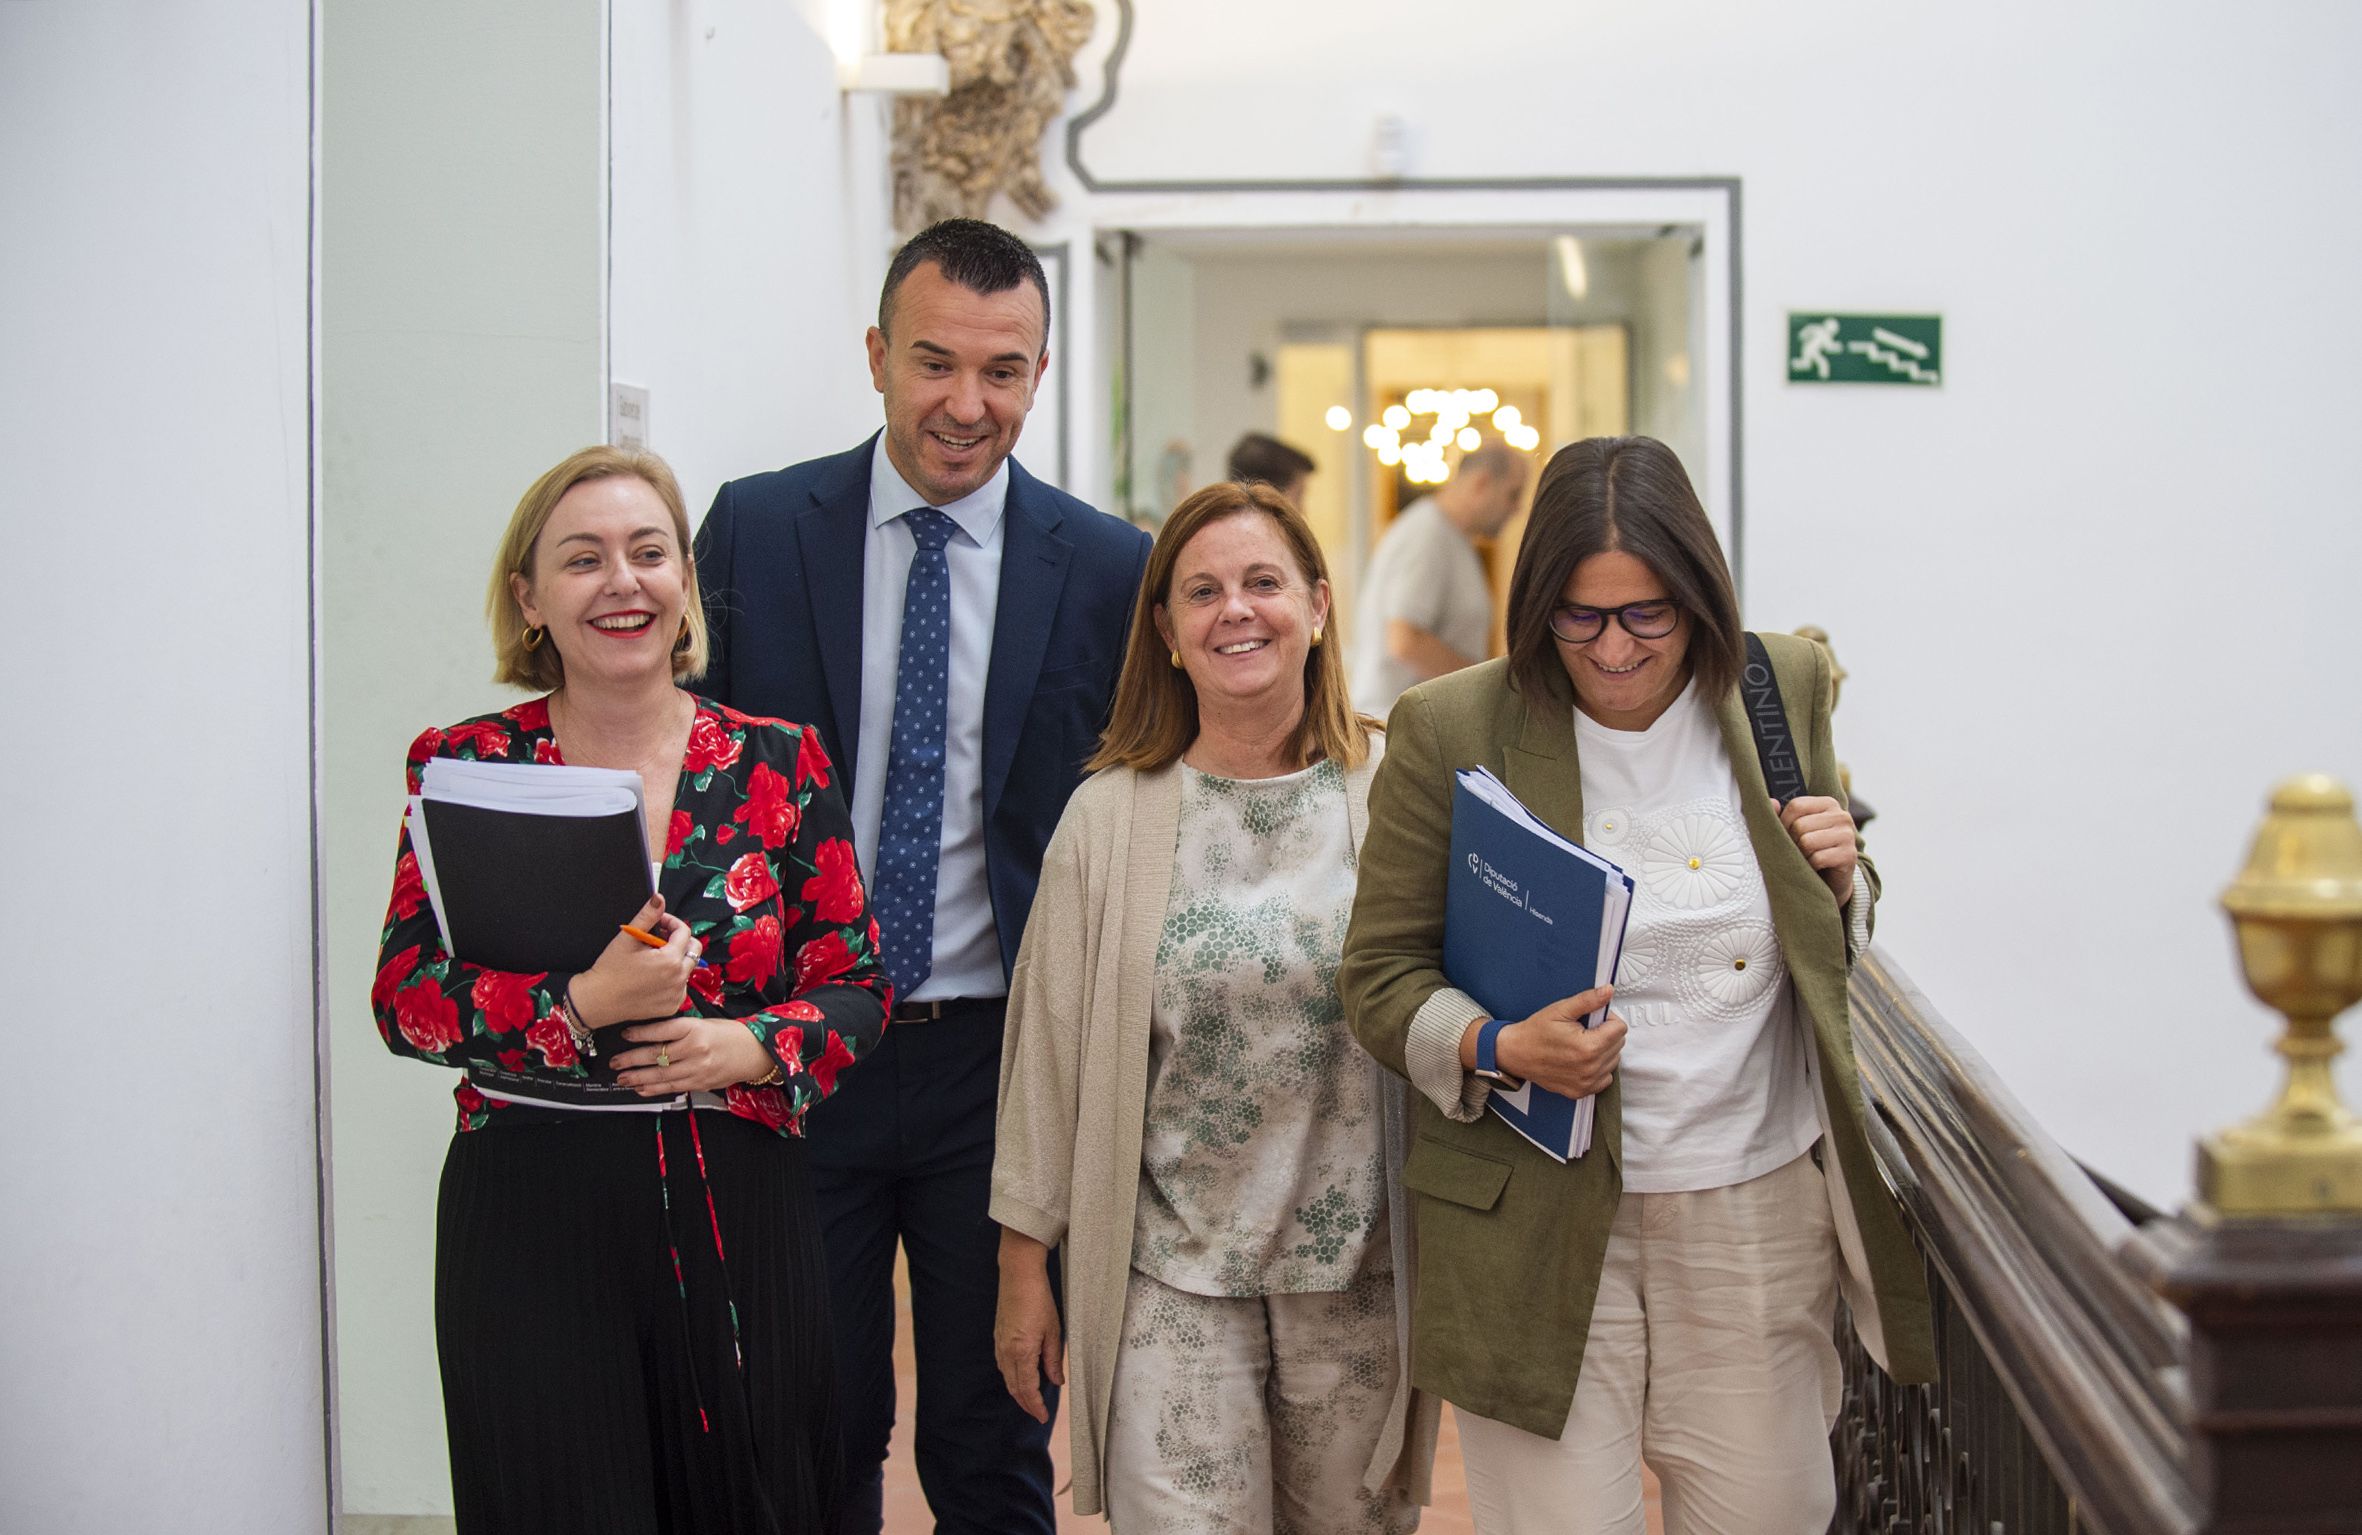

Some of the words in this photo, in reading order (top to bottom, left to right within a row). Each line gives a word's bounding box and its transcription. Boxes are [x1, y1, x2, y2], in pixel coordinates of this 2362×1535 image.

[1482, 875, 1492, 888] de
[1493, 881, 1523, 909] València
[1484, 863, 1518, 891] Diputació
